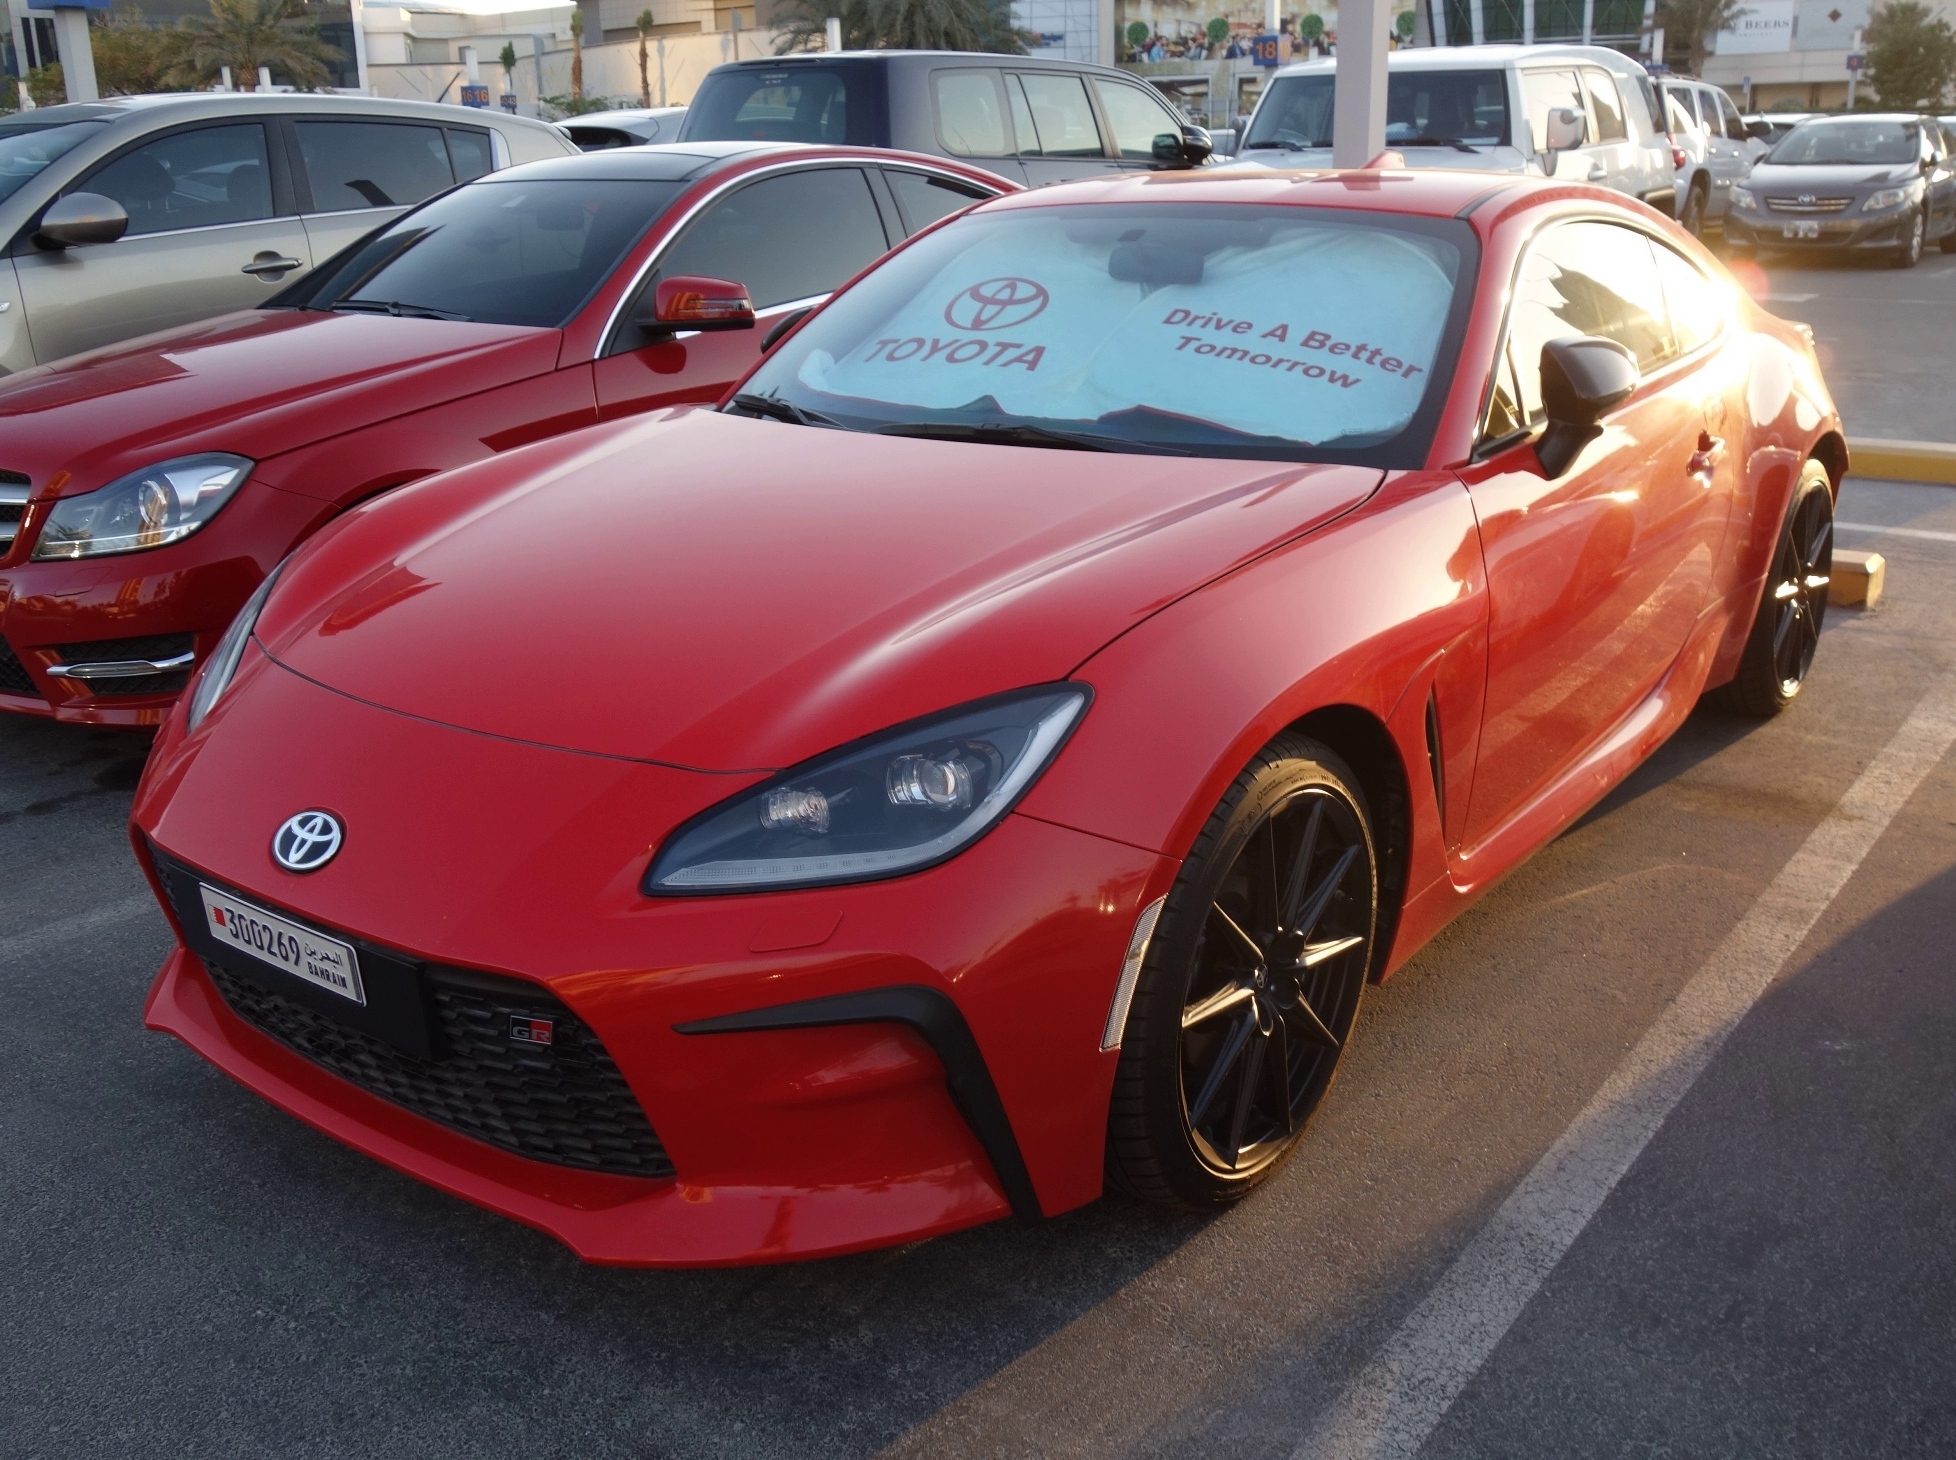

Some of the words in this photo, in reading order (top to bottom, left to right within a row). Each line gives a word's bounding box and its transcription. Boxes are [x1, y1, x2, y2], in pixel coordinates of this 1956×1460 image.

[1745, 20, 1790, 30] BEERS
[1256, 41, 1276, 60] 18
[475, 89, 488, 103] 16
[863, 337, 1047, 372] TOYOTA
[1162, 308, 1254, 334] Drive
[1260, 323, 1290, 343] A
[1300, 330, 1424, 379] Better
[1175, 335, 1362, 389] Tomorrow
[225, 907, 301, 967] 300269
[304, 942, 344, 969] البحرين
[307, 961, 349, 990] BAHRAIN
[512, 1026, 550, 1042] GR
